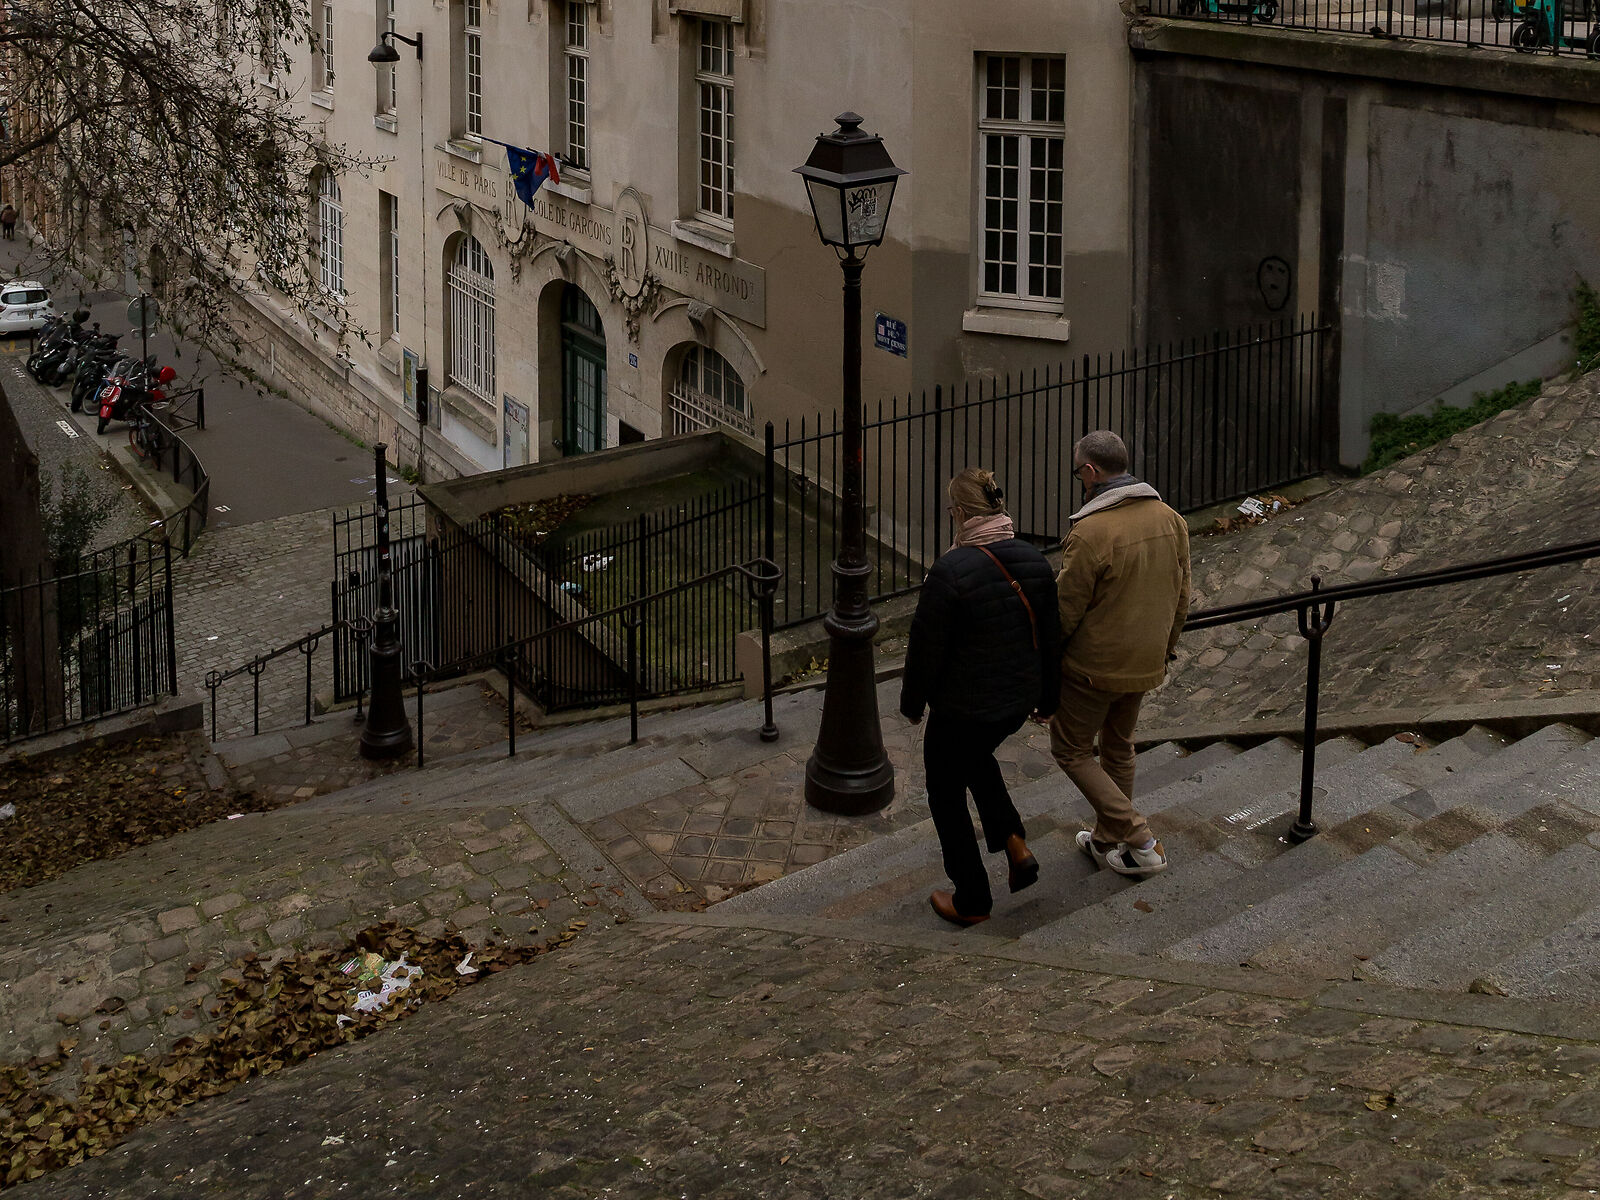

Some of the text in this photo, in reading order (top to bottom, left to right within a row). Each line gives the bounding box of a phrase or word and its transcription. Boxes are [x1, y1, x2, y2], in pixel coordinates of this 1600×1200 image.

[437, 159, 497, 198] VILLE DE PARIS
[528, 197, 555, 218] COLE
[555, 206, 567, 227] DE
